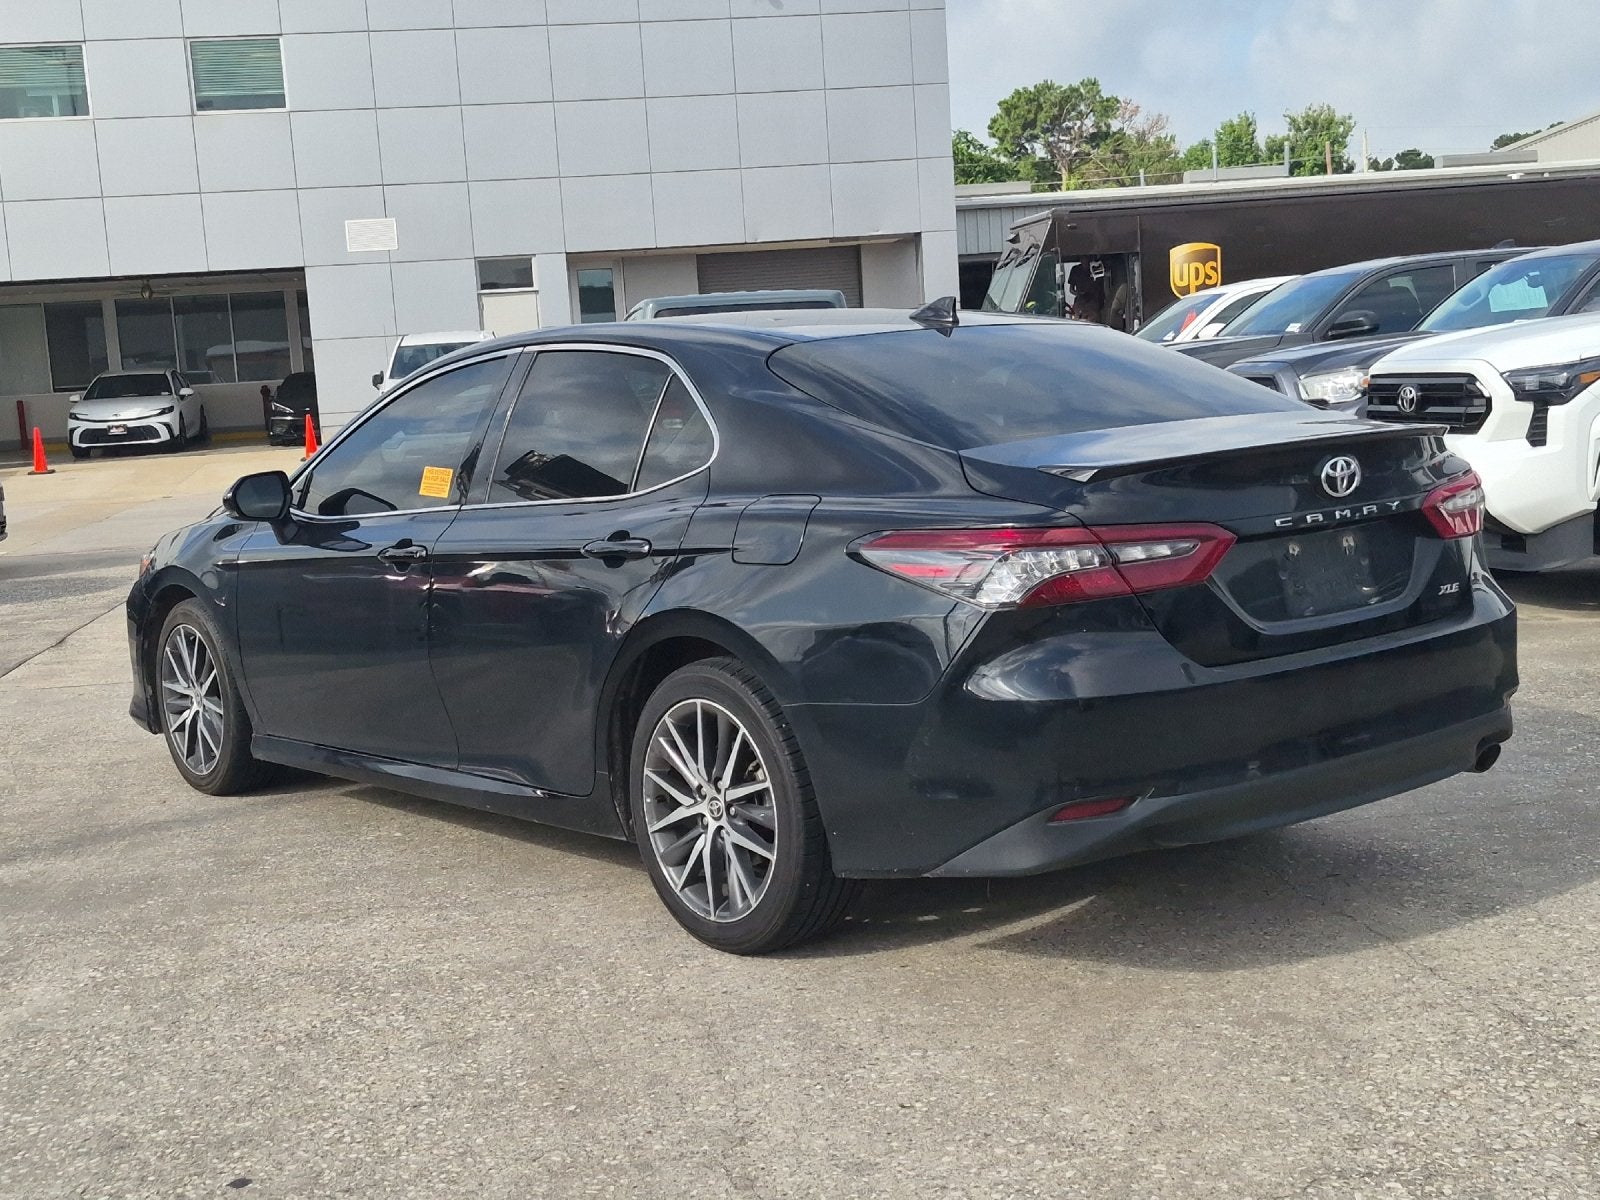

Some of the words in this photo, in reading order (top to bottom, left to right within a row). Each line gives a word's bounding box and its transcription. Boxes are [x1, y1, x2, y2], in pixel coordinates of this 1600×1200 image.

[1174, 261, 1217, 294] ups
[1275, 501, 1400, 527] CAMRY
[1438, 582, 1460, 595] XLE
